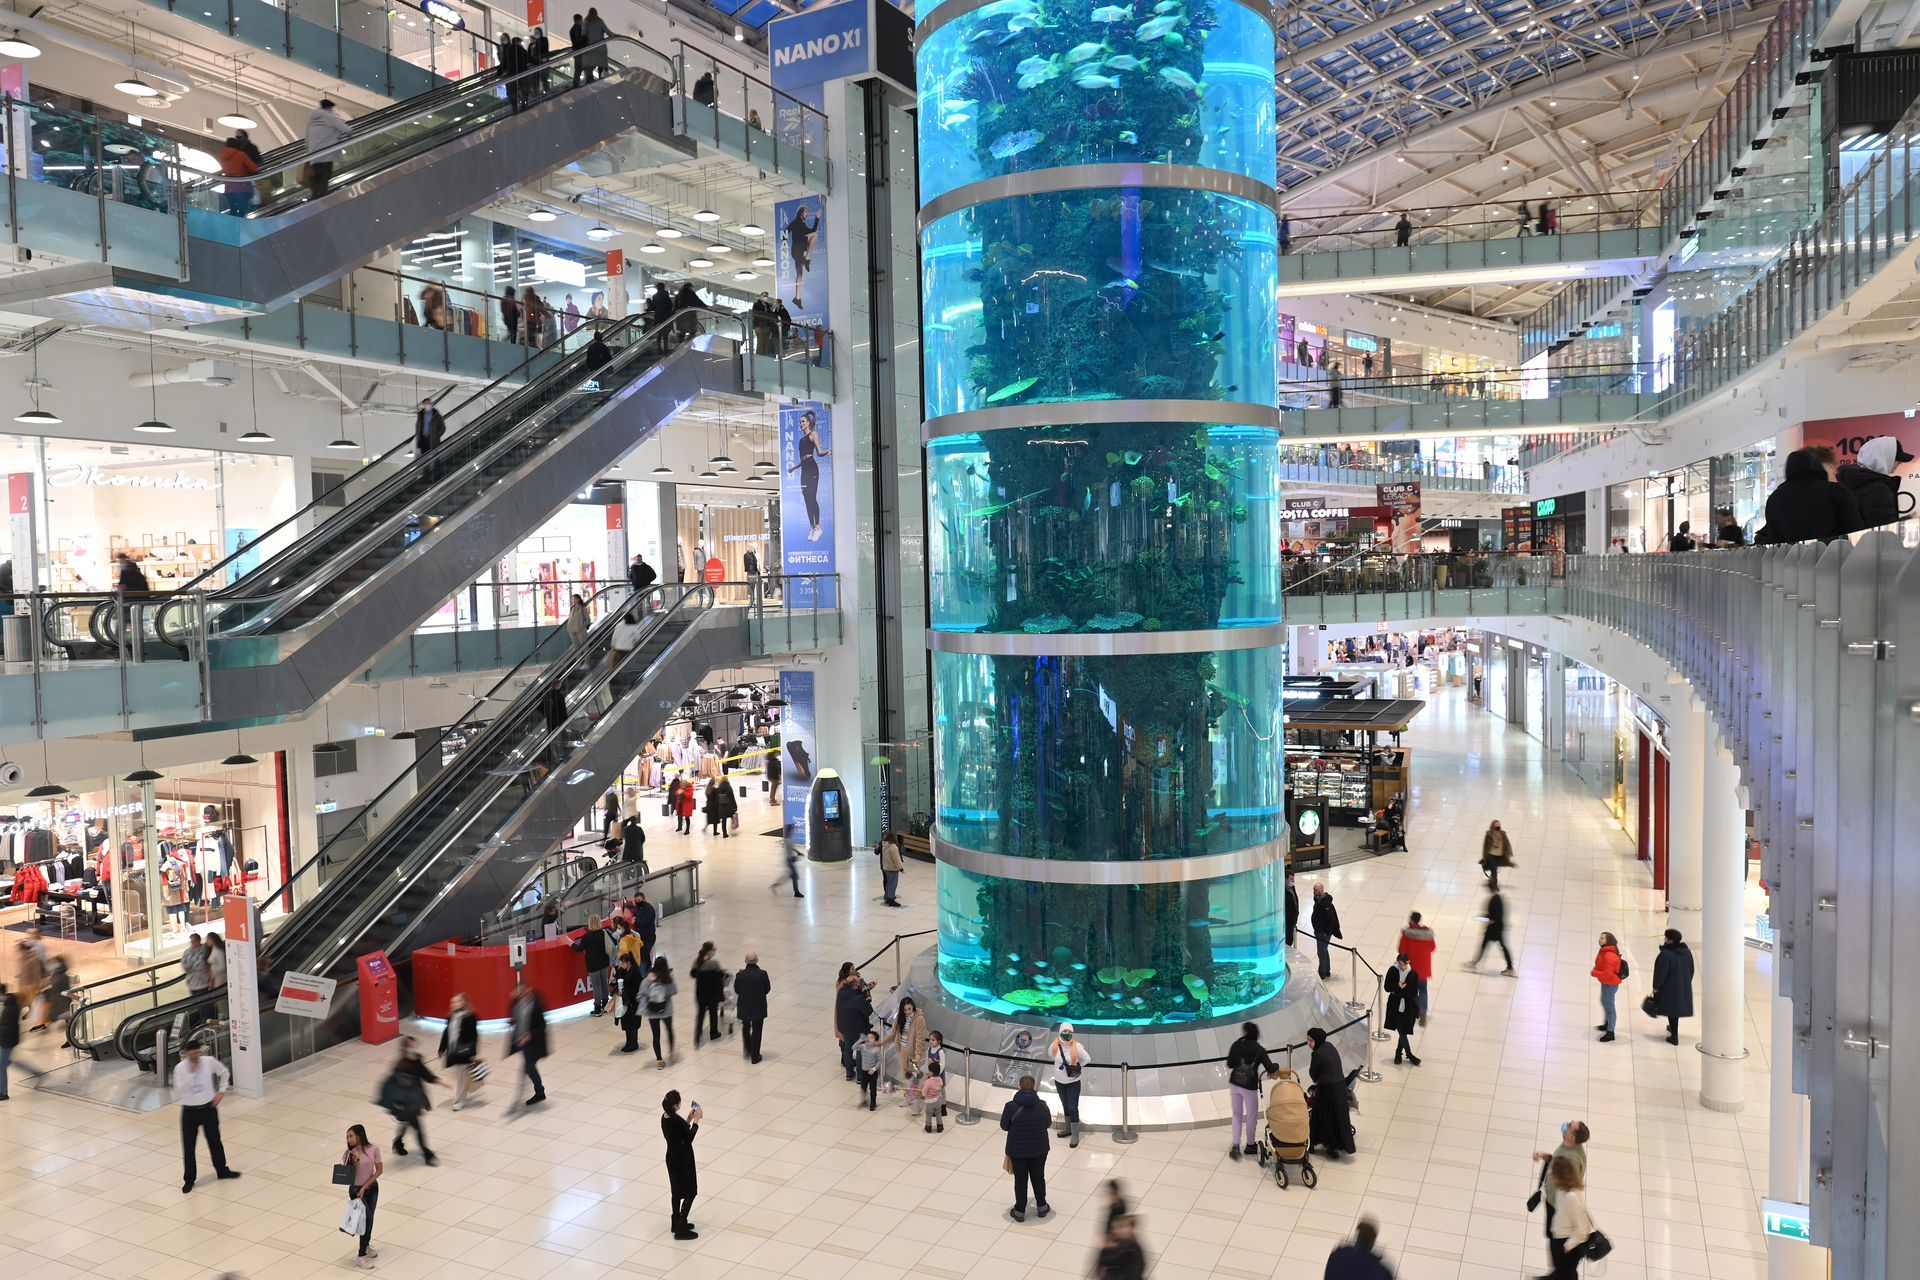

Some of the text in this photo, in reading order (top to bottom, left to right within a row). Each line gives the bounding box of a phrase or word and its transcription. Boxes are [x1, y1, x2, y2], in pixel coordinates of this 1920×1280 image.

[537, 12, 543, 23] 4
[775, 33, 840, 67] NANO
[616, 264, 622, 274] 3
[1383, 485, 1405, 493] CLUB
[1383, 492, 1413, 501] LEGACY
[20, 495, 28, 511] 2
[1311, 508, 1350, 519] COFFEE
[615, 518, 622, 528] 2
[788, 555, 829, 563] ФИТНЕСА
[84, 801, 144, 820] HILFIGER
[213, 869, 248, 892] SALE
[239, 922, 247, 939] 1
